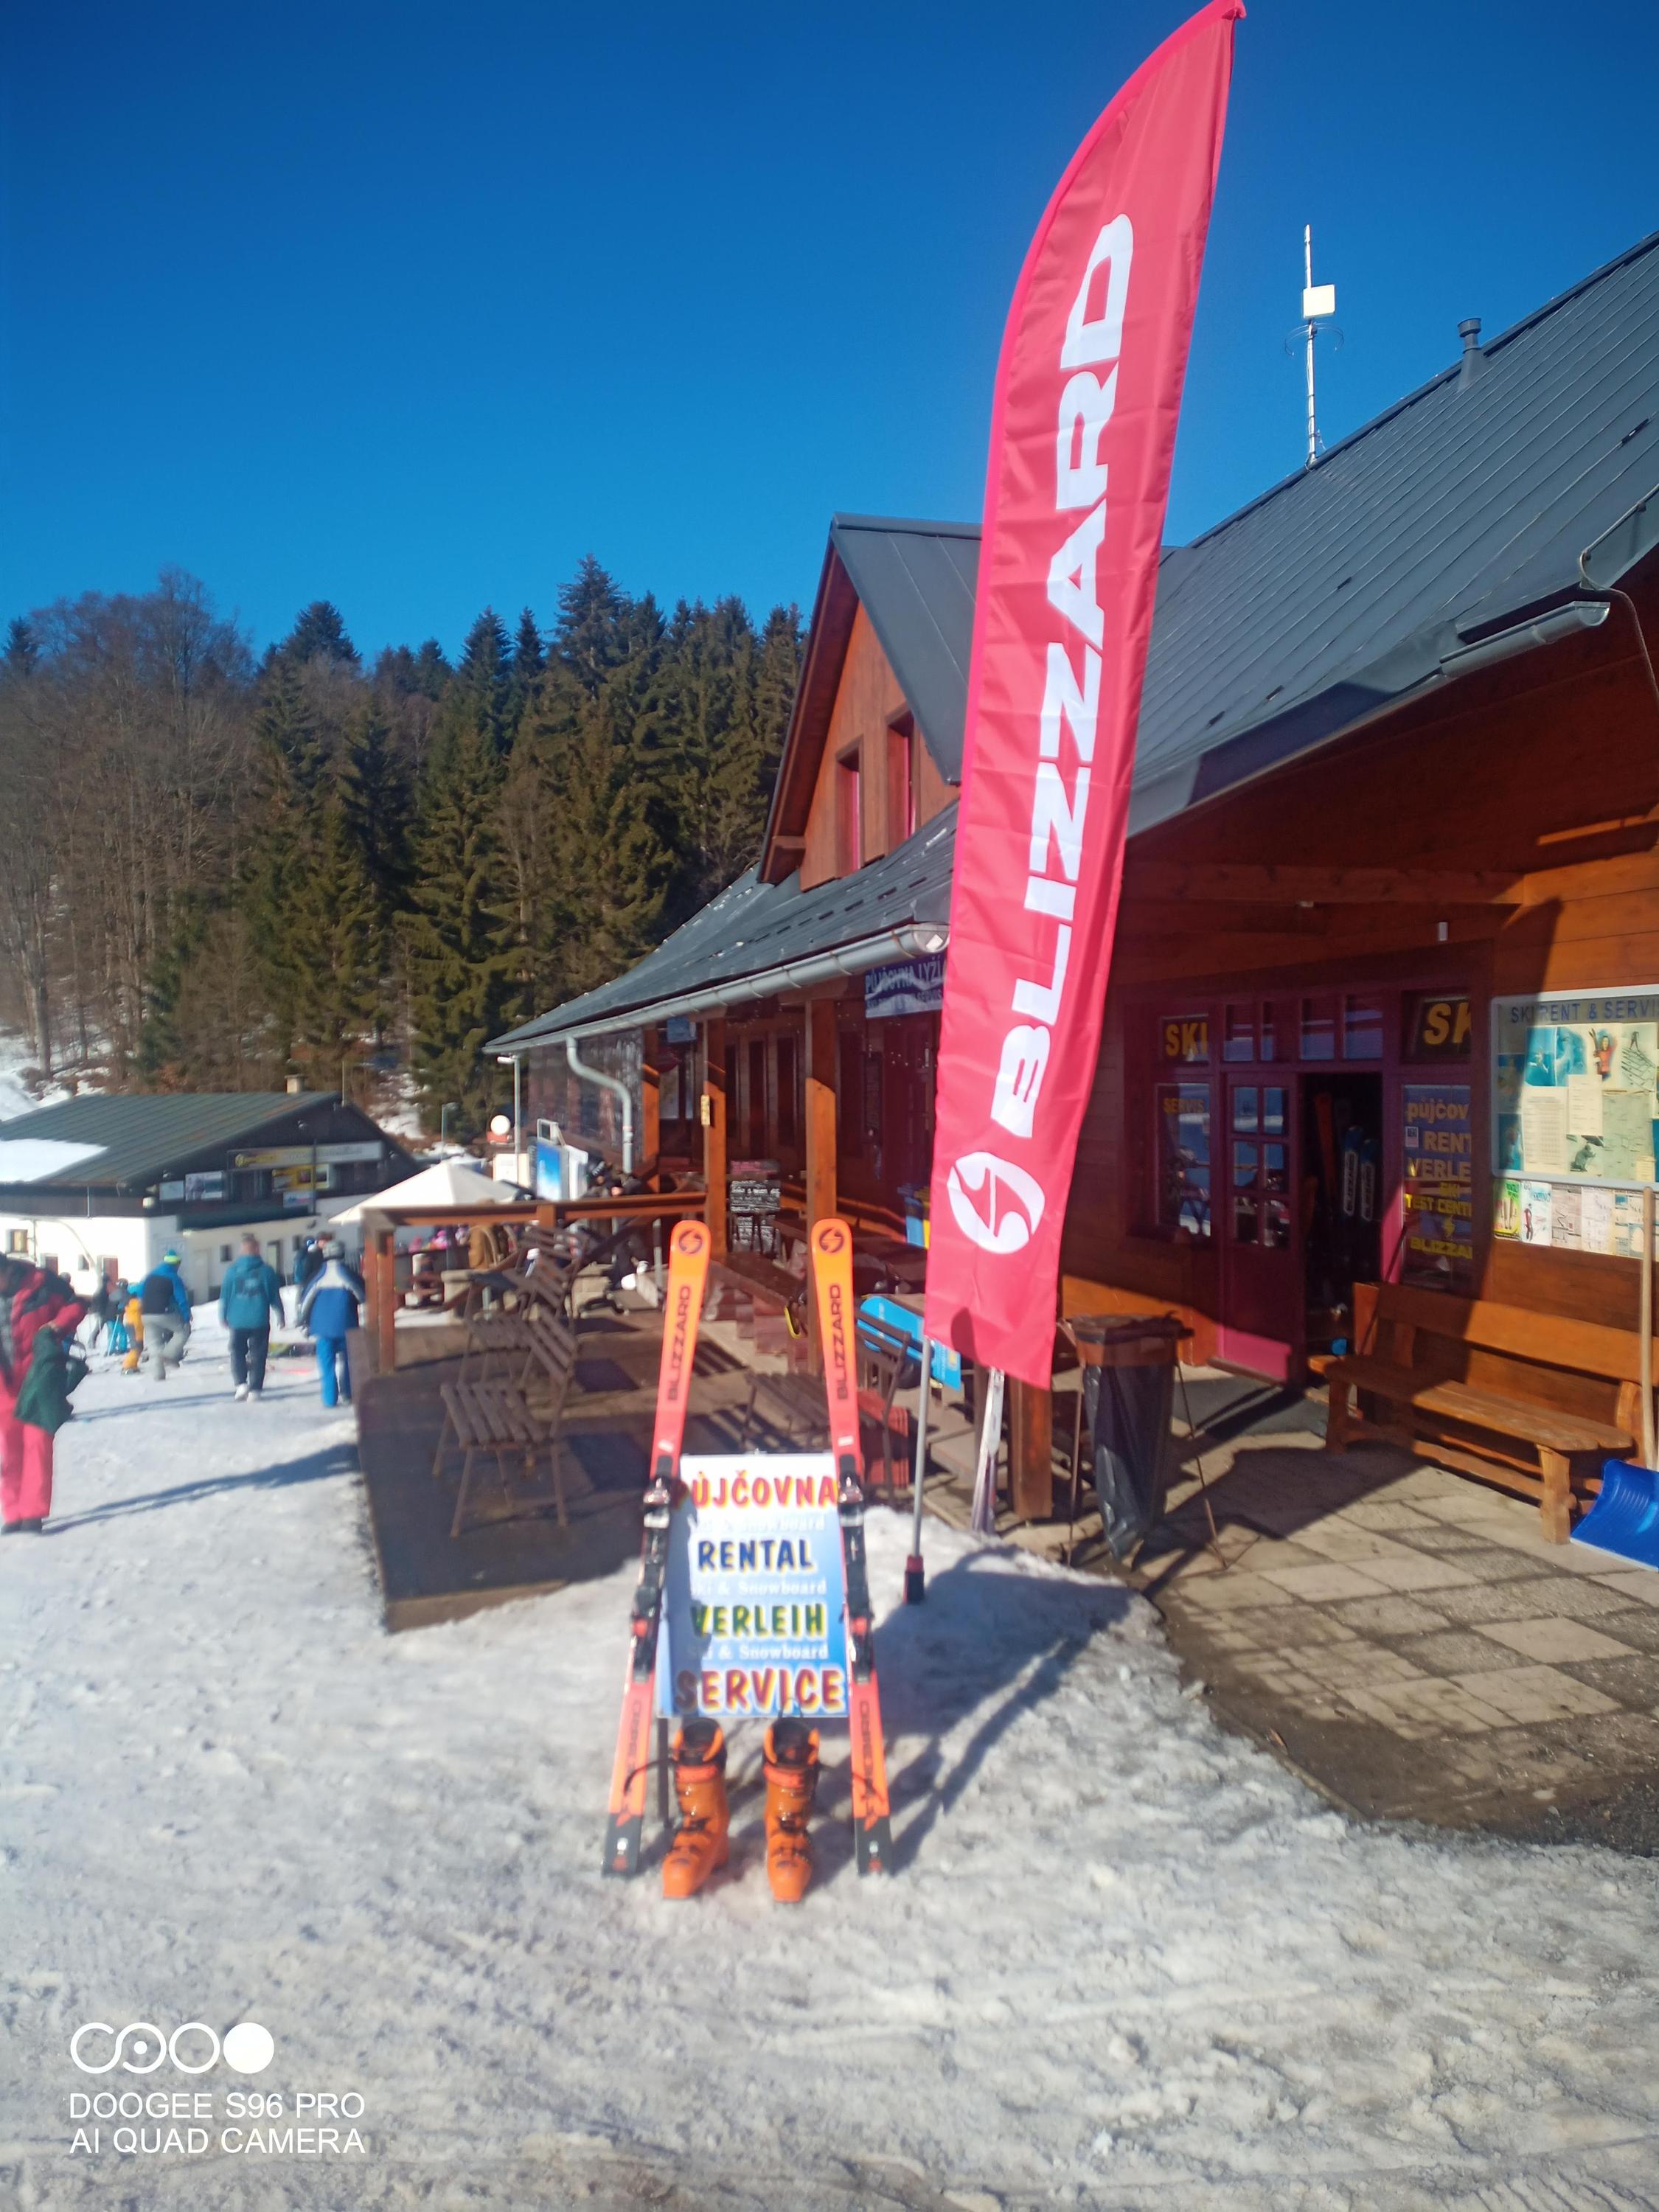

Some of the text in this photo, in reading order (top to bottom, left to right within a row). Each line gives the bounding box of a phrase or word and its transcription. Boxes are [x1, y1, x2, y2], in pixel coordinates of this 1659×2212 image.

[991, 213, 1133, 1138] BLIZZARD
[1512, 997, 1659, 1023] SKI RENT & SERVI
[1166, 1023, 1208, 1057] SKI
[1404, 1193, 1434, 1211] TEST
[667, 1286, 692, 1400] BLIZZARD
[830, 1284, 848, 1399] BLIZZARD
[698, 1539, 815, 1571] RENTAL
[737, 1576, 827, 1596] Snowboard
[690, 1603, 826, 1638] VERLEIH
[718, 1644, 732, 1660] &
[739, 1640, 829, 1660] Snowboard
[675, 1668, 845, 1714] SERVICE
